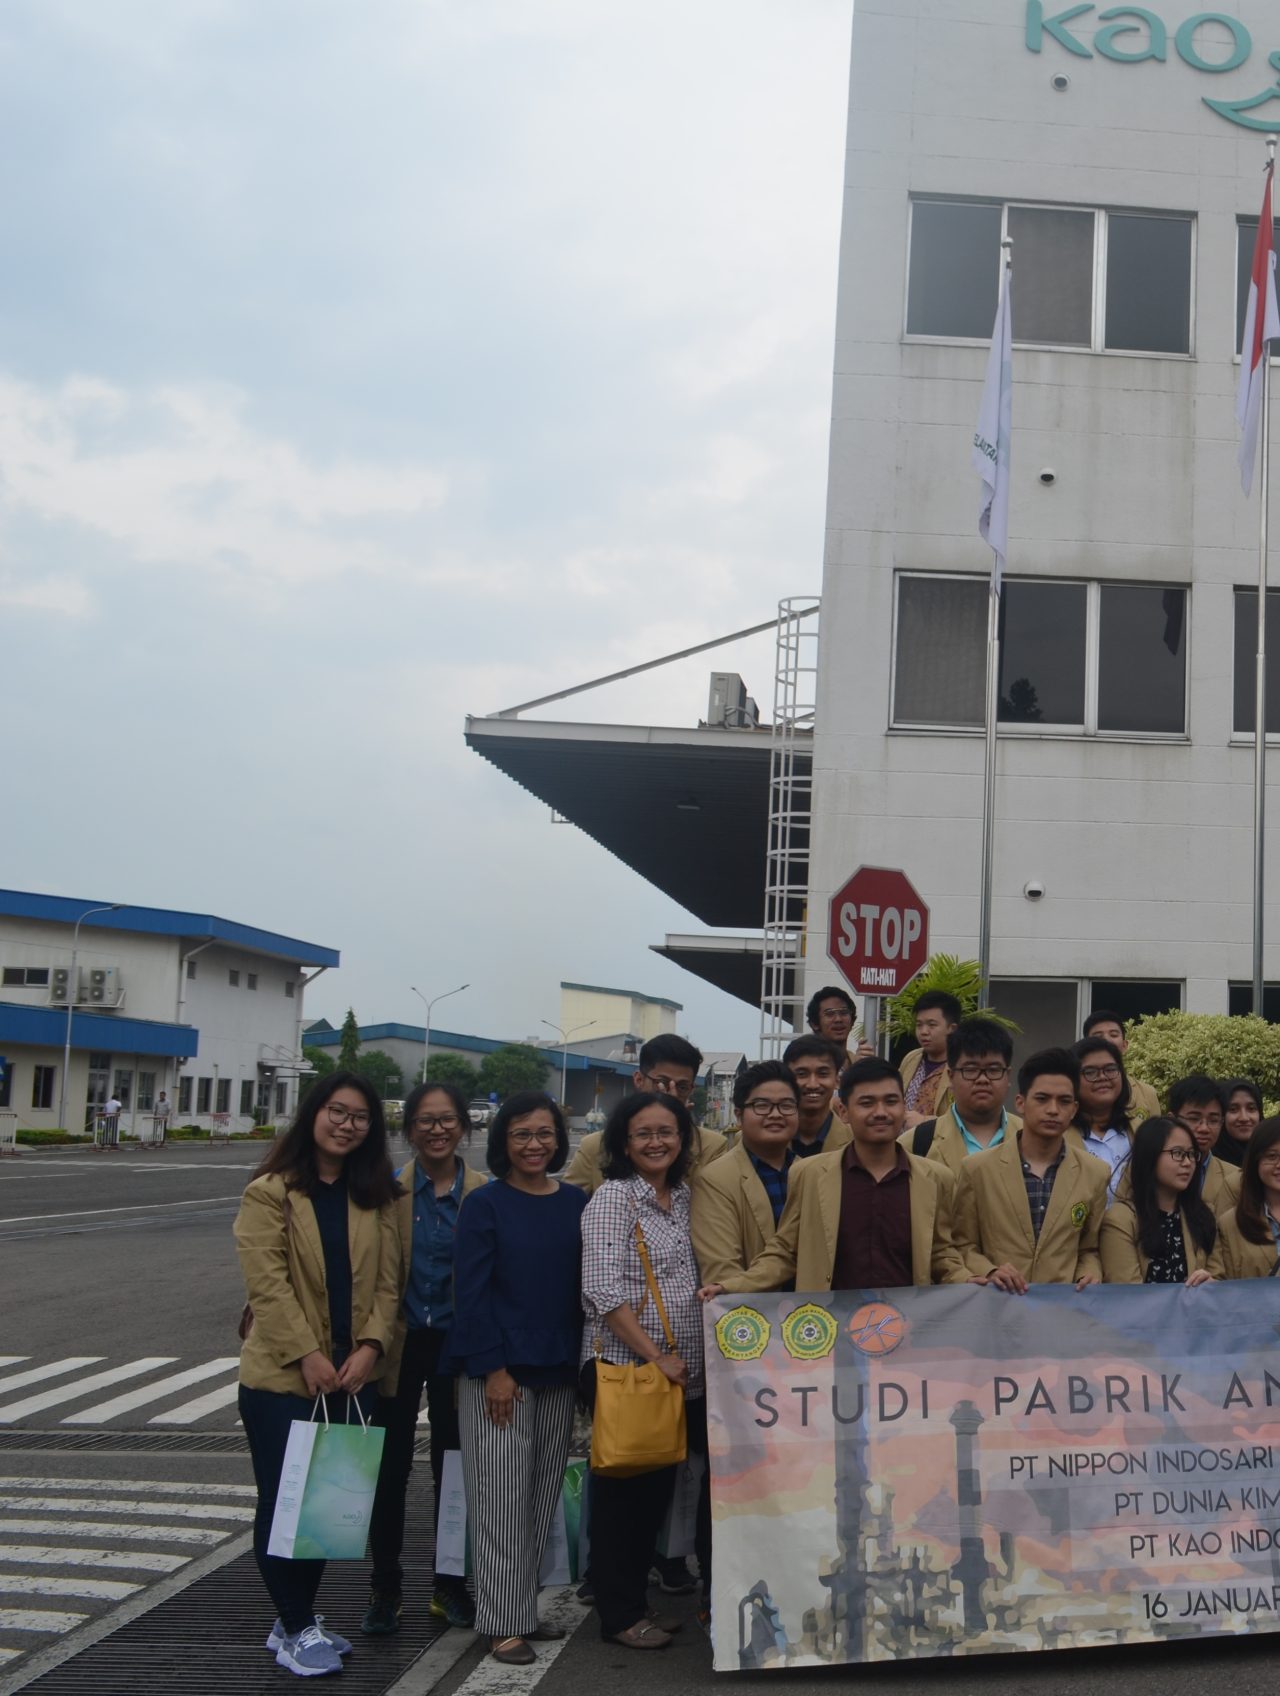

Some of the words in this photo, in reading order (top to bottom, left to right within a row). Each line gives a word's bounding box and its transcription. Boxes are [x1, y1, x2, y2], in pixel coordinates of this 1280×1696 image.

[837, 902, 922, 960] STOP
[860, 966, 897, 987] HATI-HATI
[754, 1379, 929, 1428] STUDI
[993, 1373, 1187, 1416] PABRIK
[1009, 1455, 1038, 1480] PT
[1048, 1450, 1149, 1479] NIPPON
[1156, 1444, 1274, 1473] INDOSARI
[1114, 1491, 1144, 1517] PT
[1153, 1489, 1233, 1515] DUNIA
[1129, 1534, 1159, 1559] PT
[1168, 1530, 1223, 1557] KAO
[1142, 1592, 1169, 1620] 16
